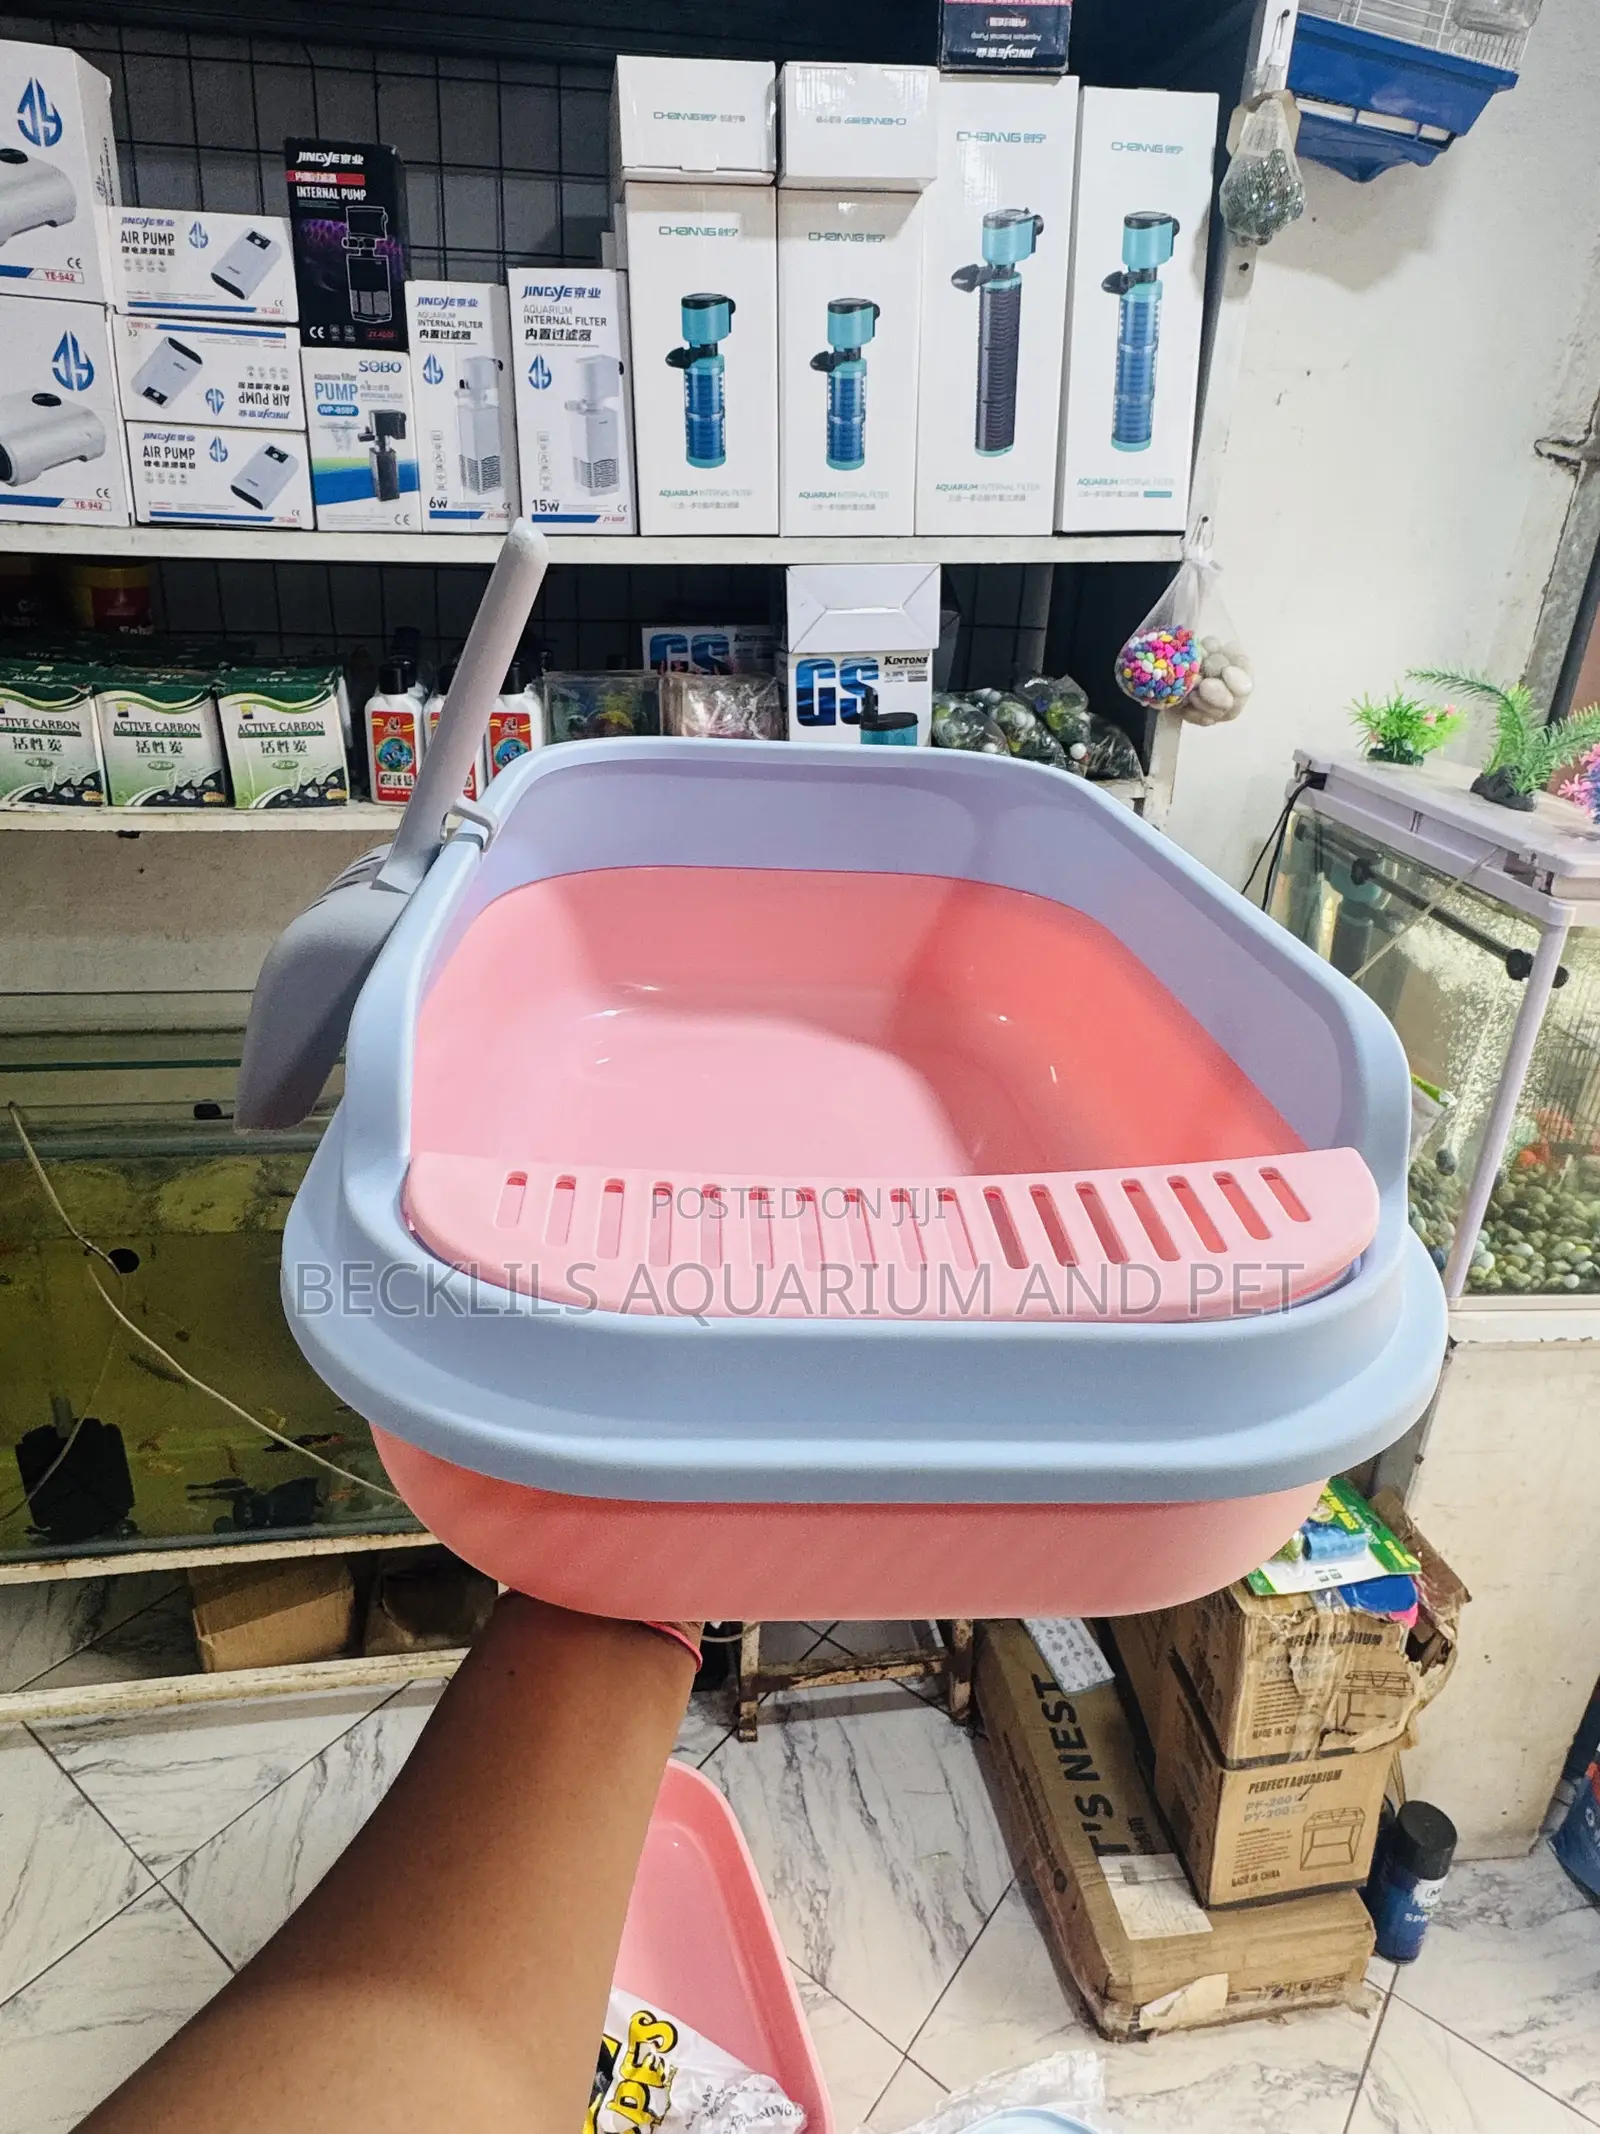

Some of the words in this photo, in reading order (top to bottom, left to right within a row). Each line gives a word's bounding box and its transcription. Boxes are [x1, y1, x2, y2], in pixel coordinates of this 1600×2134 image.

[296, 151, 340, 167] JINGYE
[296, 185, 340, 200] INTERNAL
[341, 188, 367, 201] PUMP
[120, 230, 140, 245] AIR
[142, 232, 175, 246] PUMP
[521, 285, 573, 302] JINGYE
[574, 286, 601, 299] 京业
[415, 295, 457, 310] JINGYE
[457, 297, 479, 308] 京业
[523, 304, 573, 315] AQUARIUM
[417, 311, 456, 319] AQUARIUM
[523, 315, 572, 326] INTERNAL
[575, 316, 607, 327] FILTER
[417, 319, 455, 329] INTERNAL
[458, 320, 483, 329] FILTER
[419, 329, 471, 341] 内置过滤器
[525, 328, 592, 342] 内置过滤器
[238, 392, 267, 405] PUMP
[314, 382, 358, 401] PUMP
[269, 394, 290, 406] AIR
[143, 445, 162, 459] AIR
[164, 446, 196, 460] PUMP
[33, 718, 80, 730] CARBON
[113, 721, 152, 731] ACTIVE
[154, 722, 201, 732] CARBON
[238, 722, 277, 733] ACTIVE
[279, 720, 324, 732] CARBON
[12, 736, 63, 752] 活性炭
[136, 739, 184, 754] 活性炭
[261, 739, 308, 754] 活性炭
[1031, 1671, 1100, 1782] NEST
[1248, 1777, 1290, 1795] PERFECT
[1290, 1769, 1344, 1789] AQUARIUM
[1260, 1869, 1281, 1882] CHINA
